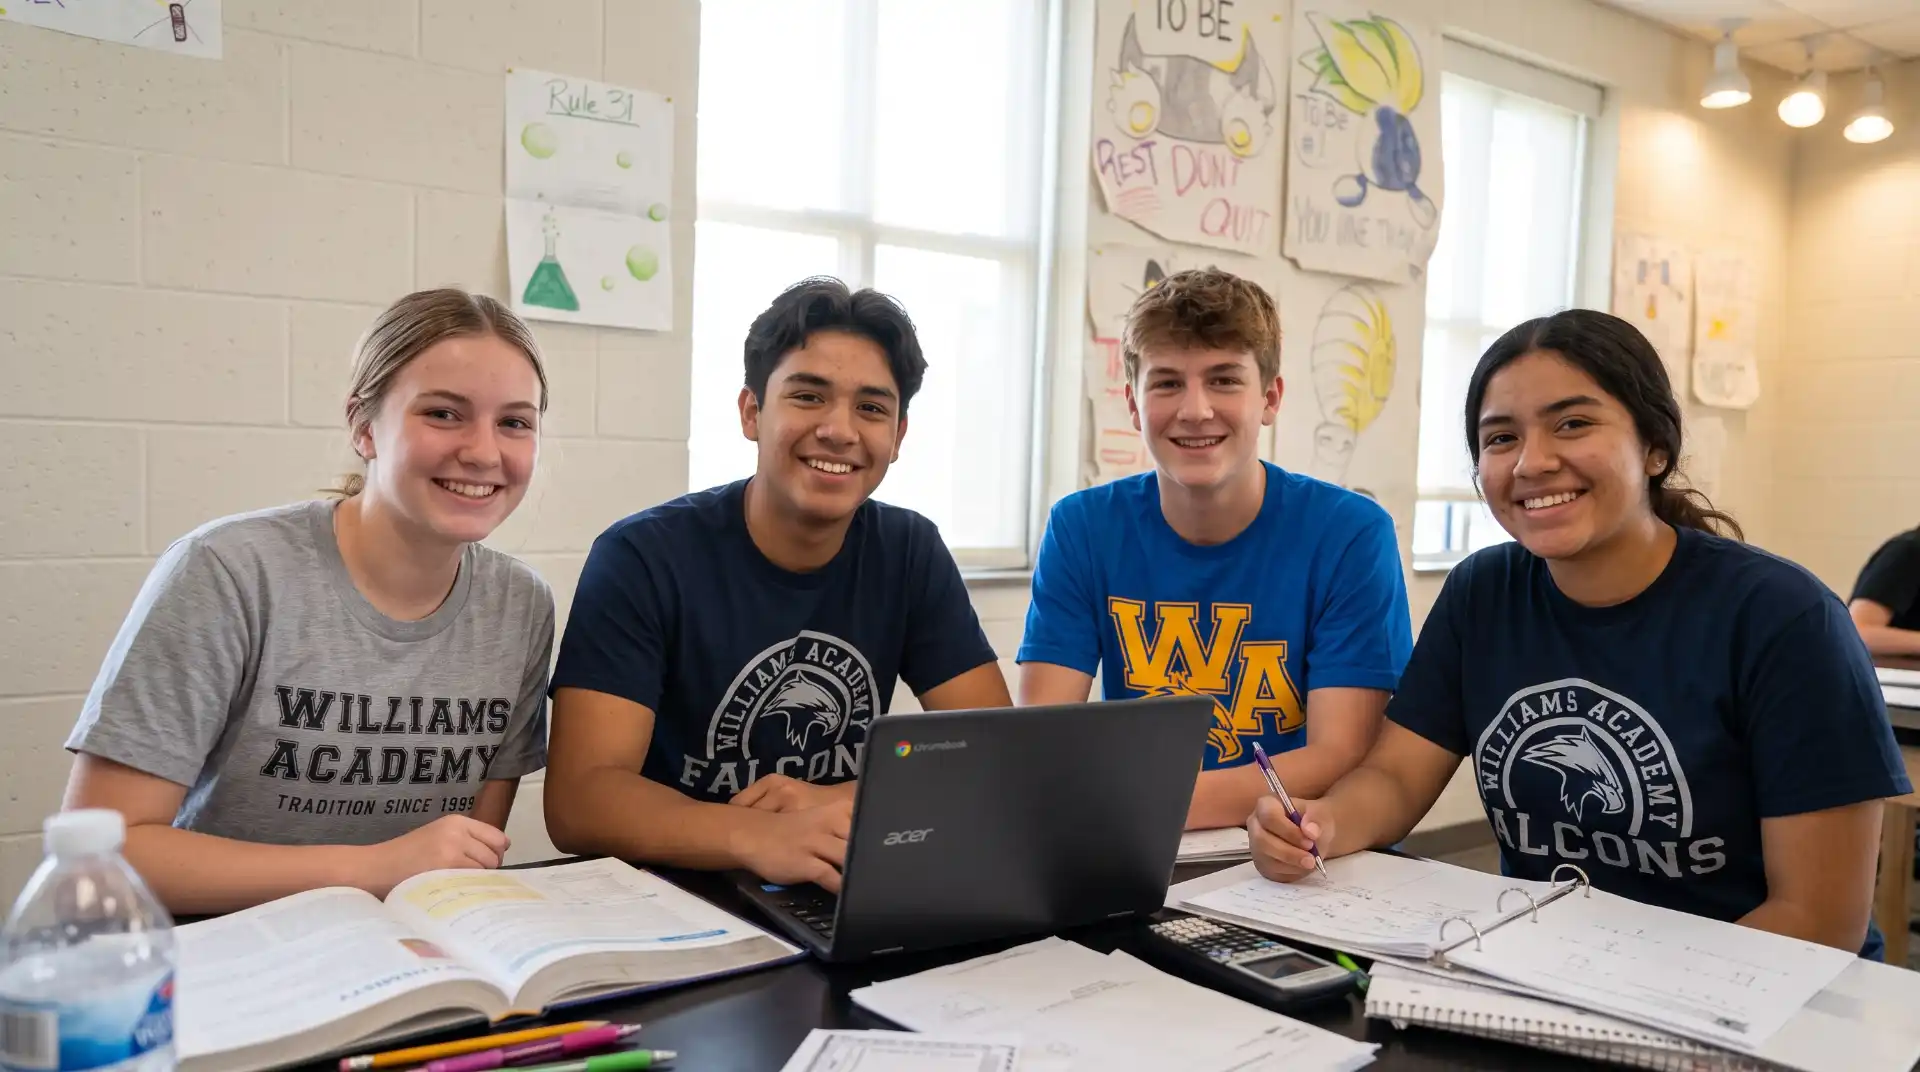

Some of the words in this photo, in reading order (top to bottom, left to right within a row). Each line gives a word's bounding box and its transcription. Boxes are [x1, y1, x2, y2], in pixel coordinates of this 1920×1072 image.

[1198, 0, 1234, 42] BE
[543, 78, 599, 116] Rule
[604, 89, 634, 121] 31
[1097, 139, 1159, 187] REST
[1200, 197, 1271, 243] QUIT
[1108, 596, 1307, 735] WA
[274, 685, 511, 735] WILLIAMS
[717, 644, 797, 751] WILLIAMS
[805, 642, 869, 731] ACADEMY
[260, 738, 500, 785] ACADEMY
[679, 743, 864, 795] FALCON
[1480, 690, 1579, 790] WILLIAMS
[1588, 699, 1678, 829] ACADEMY
[278, 794, 376, 815] TRADITION
[383, 799, 430, 814] SINCE
[441, 796, 475, 812] 1999
[883, 828, 934, 846] acer
[1491, 807, 1726, 878] ALCONS
